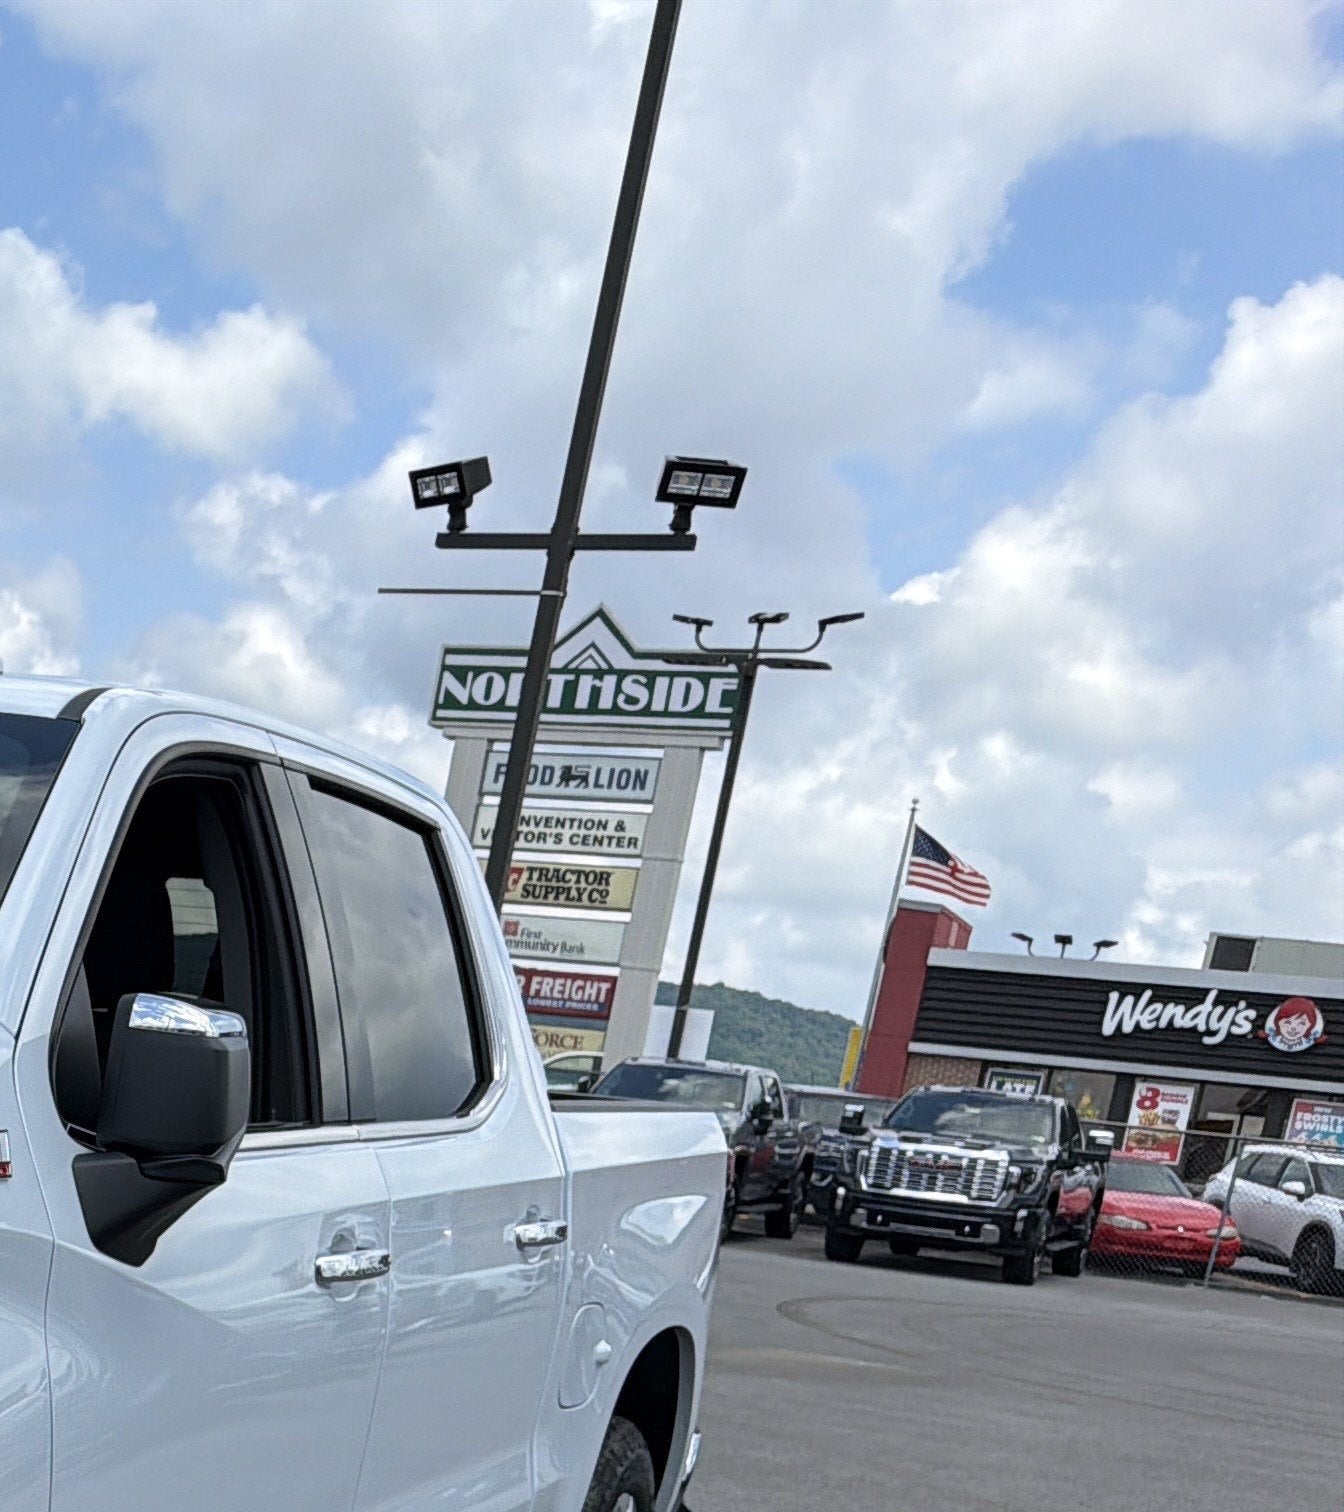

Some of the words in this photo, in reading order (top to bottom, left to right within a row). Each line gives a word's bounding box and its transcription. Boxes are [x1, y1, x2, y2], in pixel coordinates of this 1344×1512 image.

[492, 763, 553, 787] FOD
[592, 766, 649, 791] LION
[518, 815, 611, 832] NVENTION
[614, 819, 627, 833] &
[480, 827, 564, 845] VTOR'S
[568, 833, 639, 849] CENTER
[525, 866, 613, 887] TRACTOR
[520, 883, 587, 903] SUPPLY
[529, 976, 612, 1003] FREIGHT
[1101, 988, 1257, 1046] Wendy's
[534, 1027, 584, 1049] ORCE
